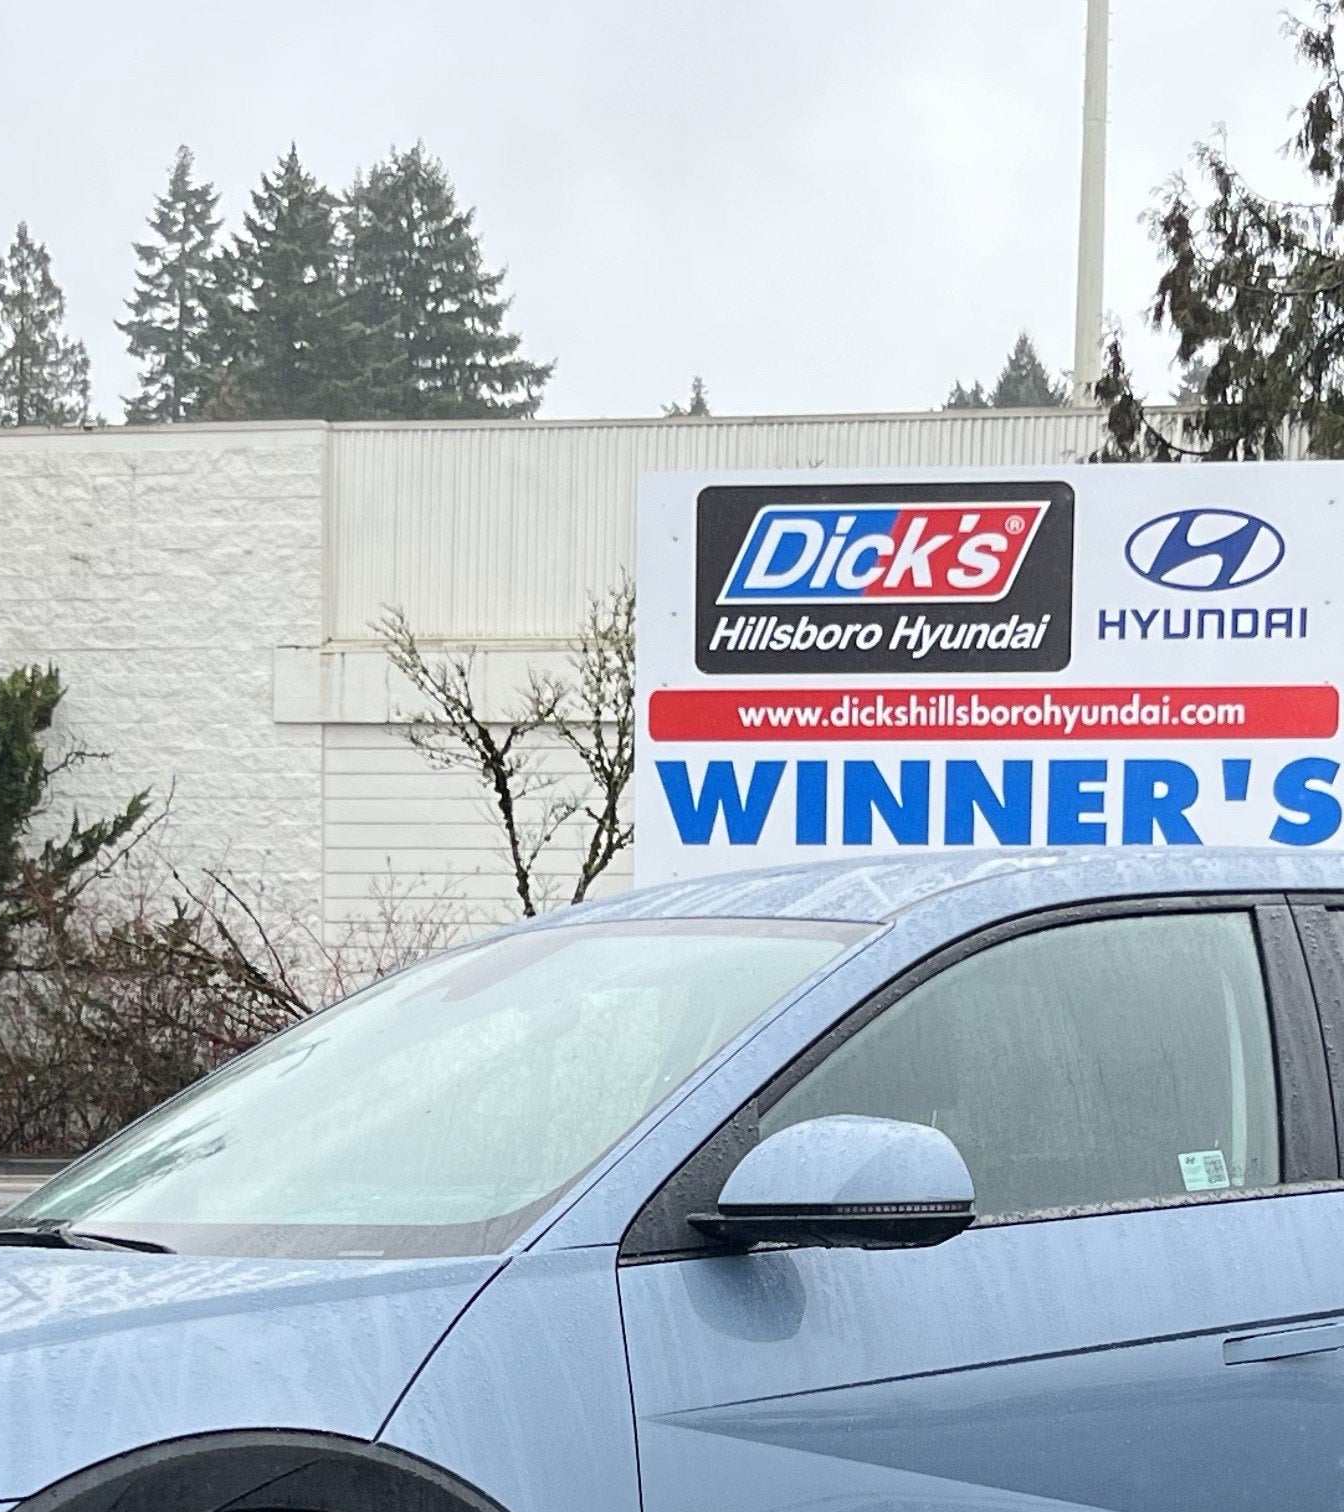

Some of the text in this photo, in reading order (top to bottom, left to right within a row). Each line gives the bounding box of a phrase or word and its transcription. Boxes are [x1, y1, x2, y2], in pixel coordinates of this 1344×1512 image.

[742, 514, 1009, 590] Dick's
[708, 613, 1052, 659] Hillsboro Hyundai
[1098, 606, 1309, 641] HYUNDAI
[737, 694, 1247, 736] www.dickshillsborohyundai.com
[653, 756, 1344, 847] WINNER'S
